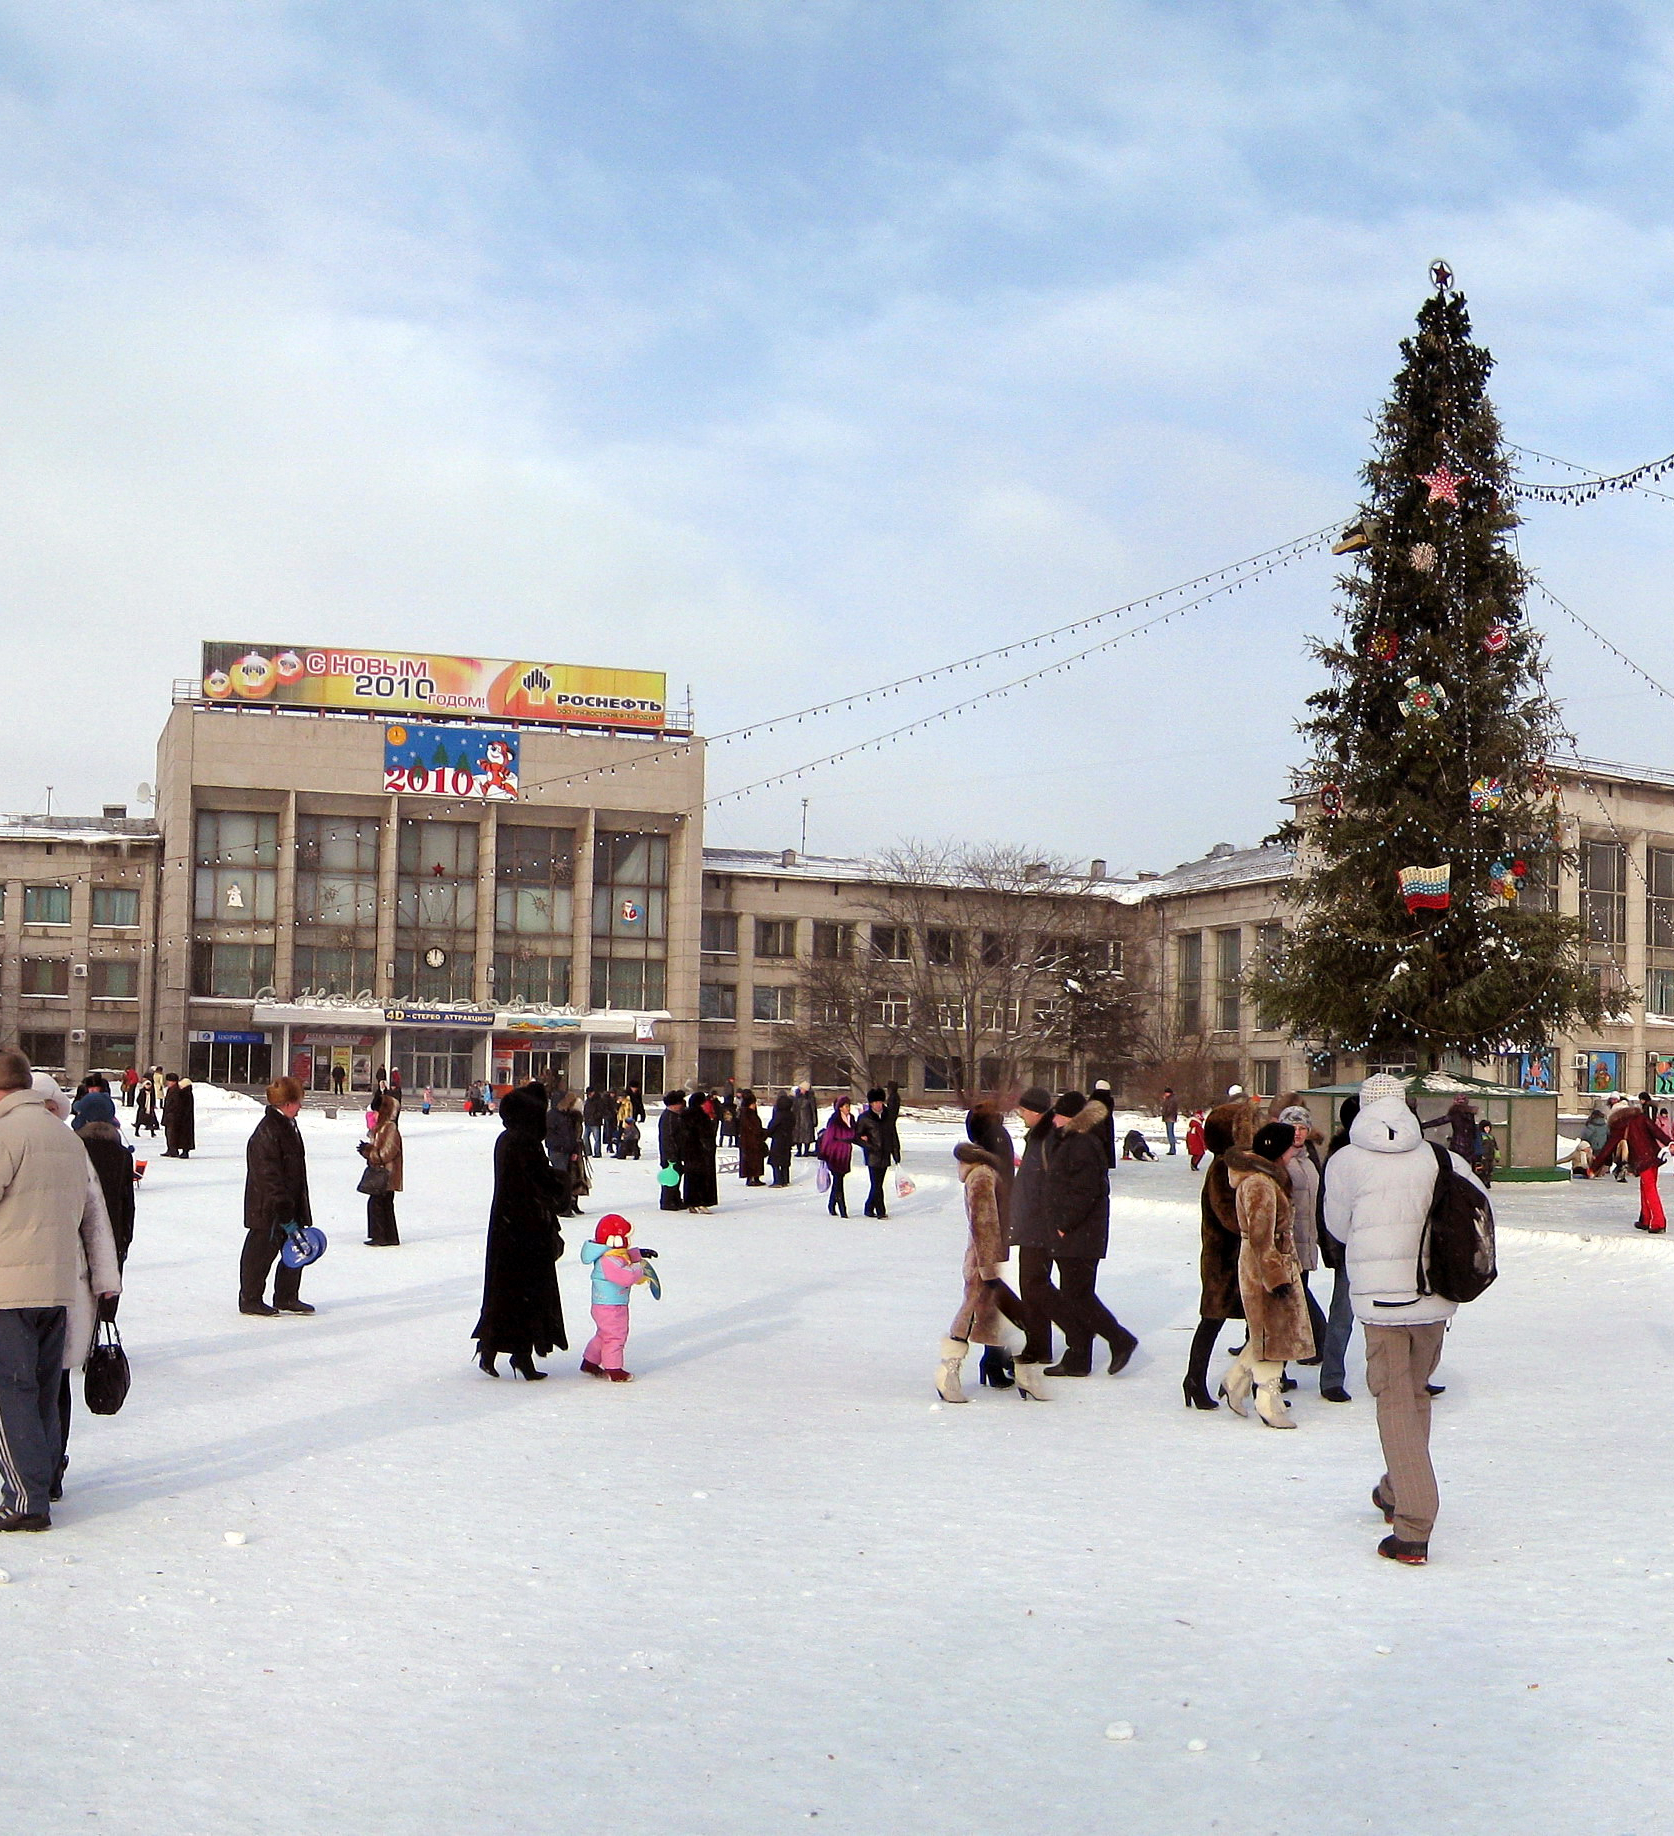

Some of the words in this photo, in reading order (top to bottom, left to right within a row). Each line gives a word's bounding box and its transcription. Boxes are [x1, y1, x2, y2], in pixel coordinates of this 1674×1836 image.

[308, 653, 326, 672] С
[332, 655, 427, 678] НОВЫМ
[355, 675, 435, 700] 2010
[428, 693, 486, 709] ГОДОМ!
[557, 694, 662, 712] РОСНЕФТЬ
[384, 764, 474, 797] 2010
[385, 1010, 405, 1021] 4D
[443, 1014, 494, 1023] АТТРАКЦИОН
